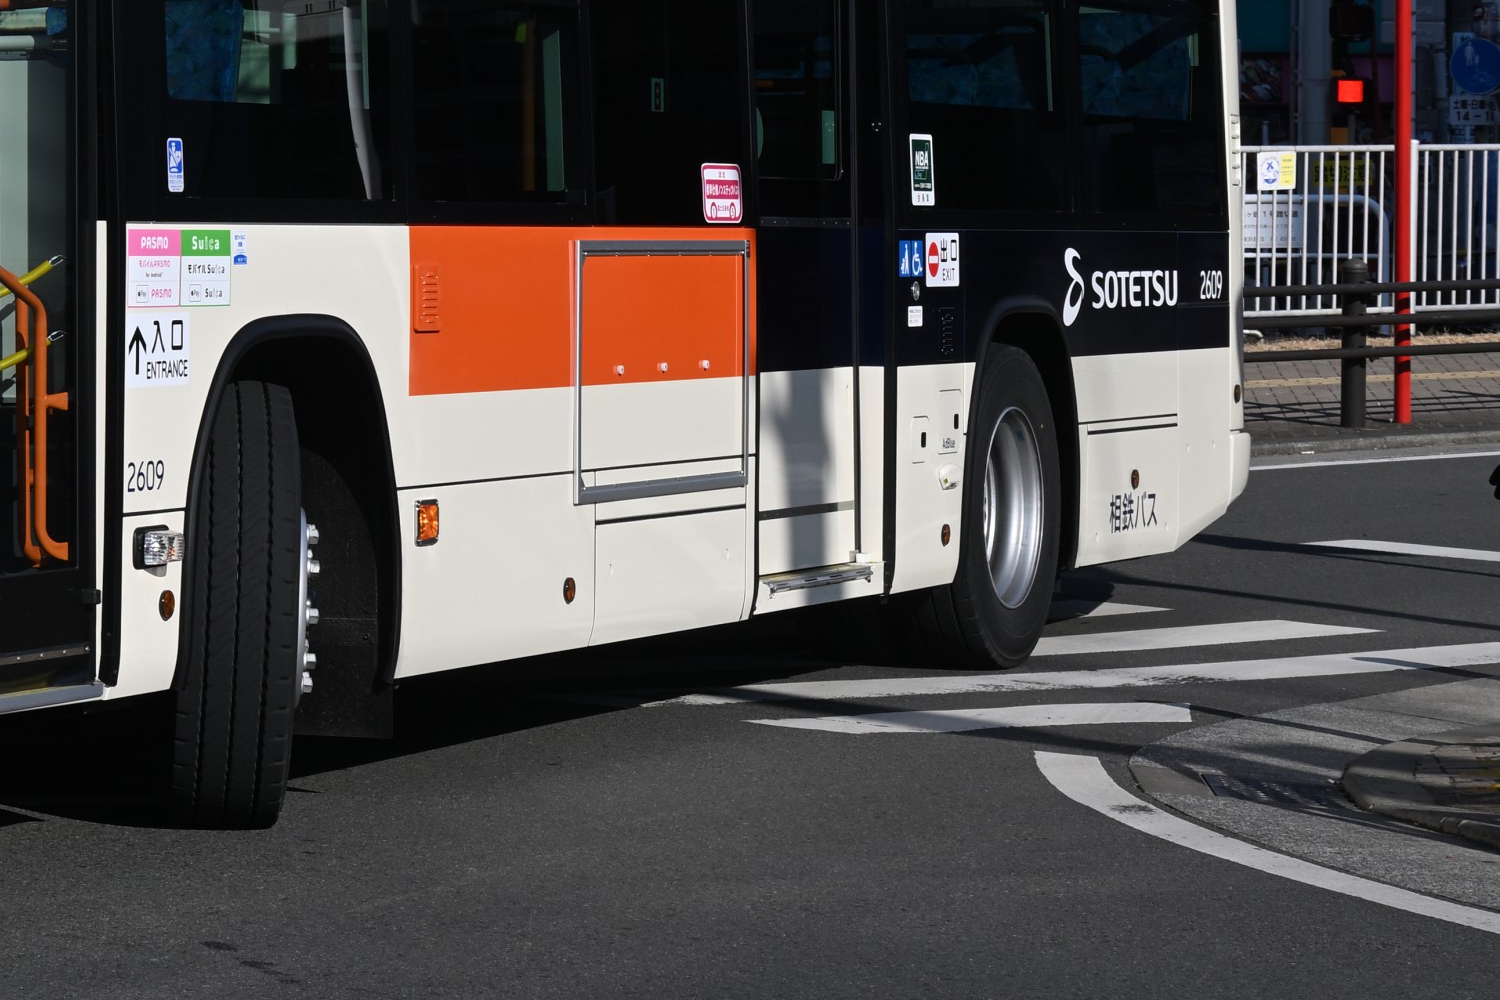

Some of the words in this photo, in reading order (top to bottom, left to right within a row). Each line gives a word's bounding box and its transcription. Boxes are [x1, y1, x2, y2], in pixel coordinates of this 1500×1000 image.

[915, 150, 929, 166] NBA
[141, 236, 169, 249] PASMO
[191, 235, 220, 250] Suica
[940, 238, 957, 262] 出口
[942, 267, 955, 281] EXIT
[1200, 269, 1223, 300] 2609
[151, 289, 172, 298] PASMO
[204, 288, 223, 298] Suica
[1091, 269, 1178, 309] SOTETSU
[151, 319, 184, 354] 入口
[146, 359, 189, 380] ENTRANCE
[127, 459, 165, 492] 2609
[1109, 490, 1158, 534] 相鉄バス
